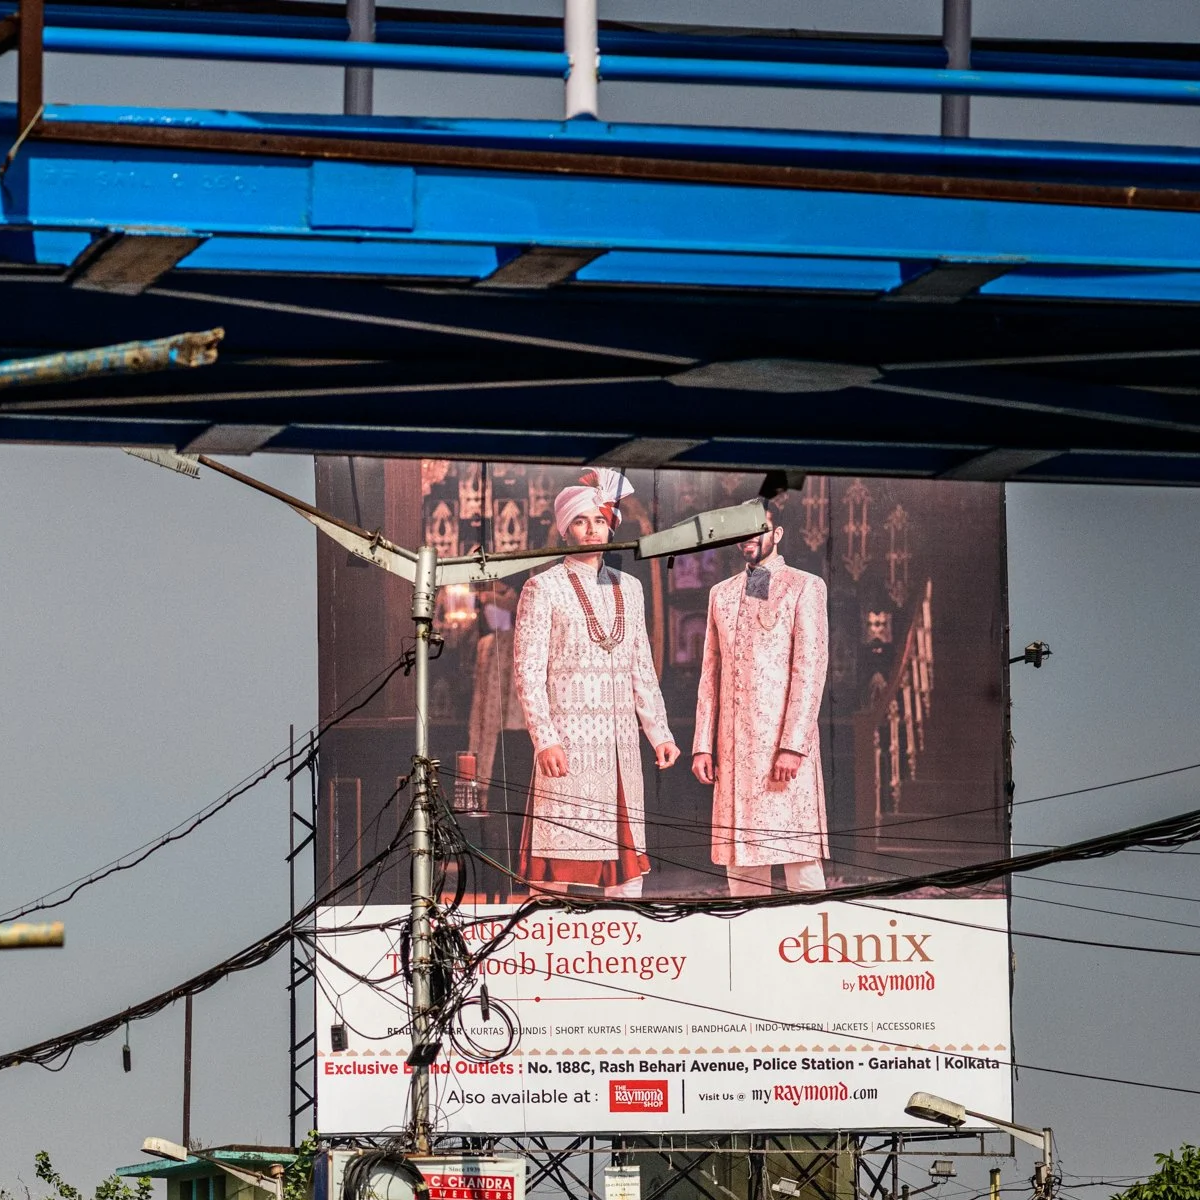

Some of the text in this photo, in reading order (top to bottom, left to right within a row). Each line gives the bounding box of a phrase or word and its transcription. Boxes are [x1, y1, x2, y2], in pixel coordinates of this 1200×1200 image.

[516, 916, 642, 946] Sajengey,
[779, 912, 934, 967] ethnix
[545, 951, 687, 981] Jachengey
[843, 971, 935, 996] by Raymond
[512, 1026, 547, 1035] BUNDIS
[555, 1025, 621, 1035] SHORT KURTAS
[630, 1025, 683, 1034] SHERWANIS
[691, 1024, 747, 1033] BANDHGALA
[755, 1023, 823, 1033] INDO-WESTERN
[832, 1022, 868, 1032] JACKETS
[876, 1021, 936, 1031] ACCESSORIES
[470, 1027, 504, 1036] KURTAS
[324, 1061, 407, 1076] Exclusive
[527, 1061, 552, 1075] No.
[556, 1060, 596, 1077] 188C,
[599, 1060, 634, 1074] Rash
[639, 1059, 686, 1073] Behari
[690, 1058, 749, 1075] Avenue,
[753, 1058, 797, 1071] Police
[801, 1057, 855, 1071] Station
[868, 1056, 931, 1070] Gariahat
[945, 1056, 1000, 1070] Kolkata
[446, 1089, 487, 1104] Also
[490, 1089, 570, 1104] available
[615, 1088, 663, 1104] Raymond
[698, 1092, 720, 1102] Visit
[722, 1092, 734, 1102] Us
[447, 1176, 512, 1190] CHANDRA
[428, 1189, 512, 1200] EWELLERS
